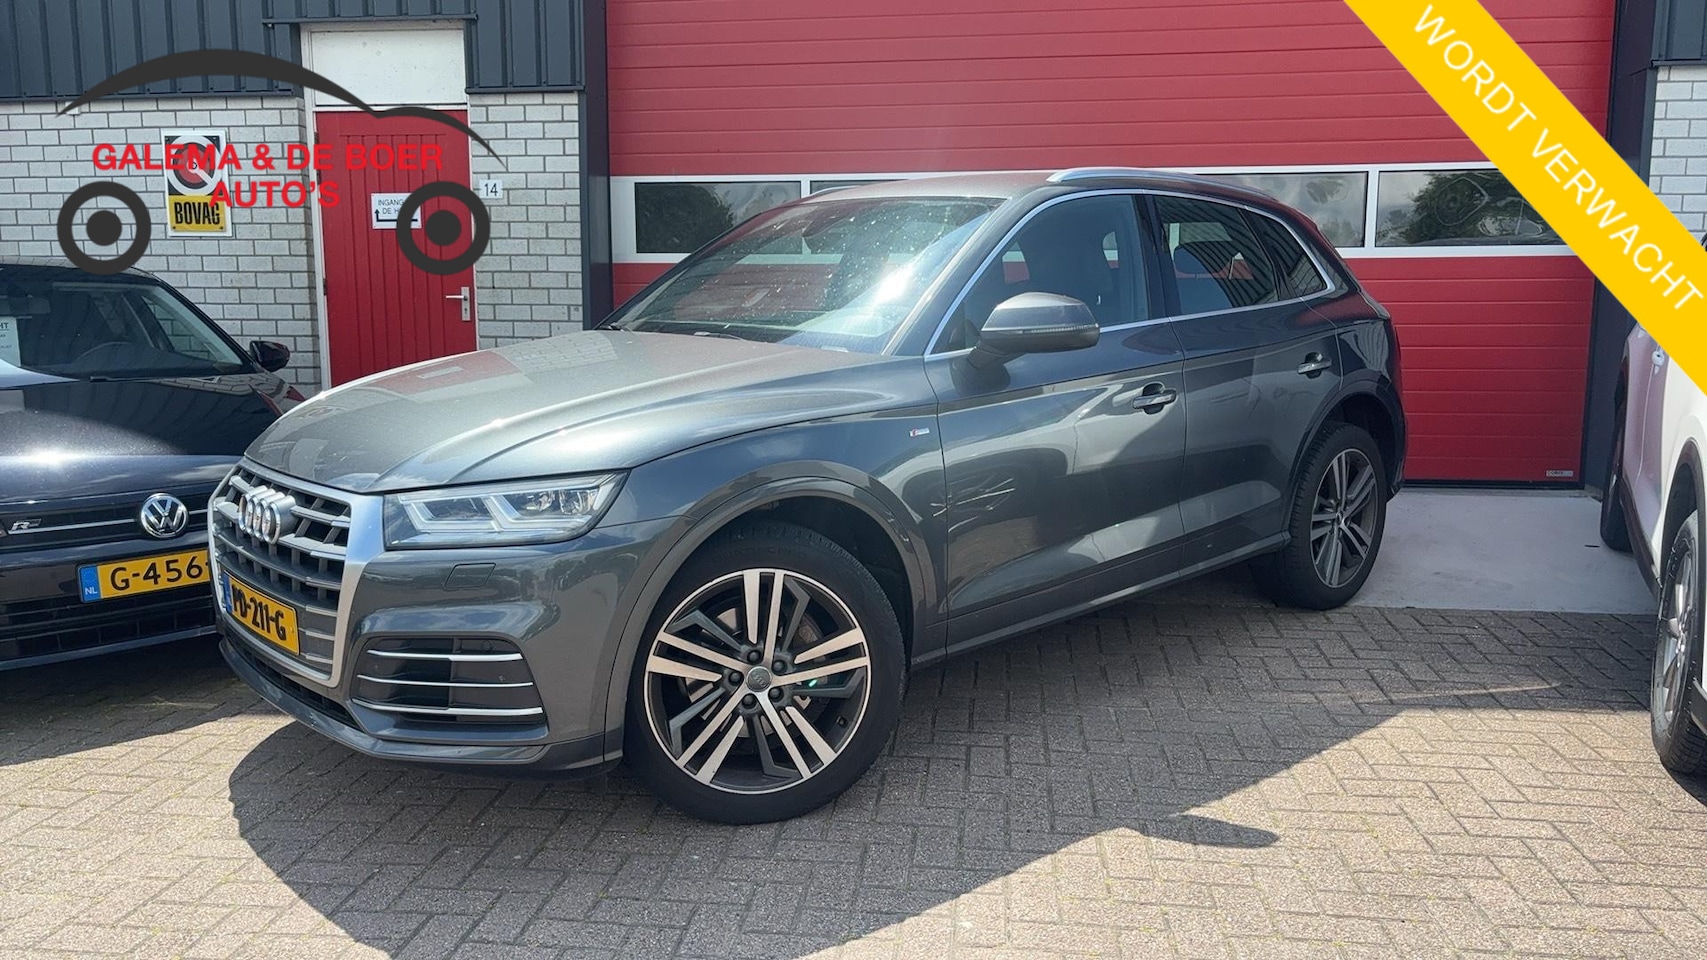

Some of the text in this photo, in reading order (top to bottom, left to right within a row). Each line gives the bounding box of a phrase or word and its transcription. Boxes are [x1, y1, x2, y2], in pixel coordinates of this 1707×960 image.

[484, 182, 499, 197] 14
[174, 202, 220, 225] BOVAG
[382, 207, 392, 215] DE
[84, 586, 98, 595] NL
